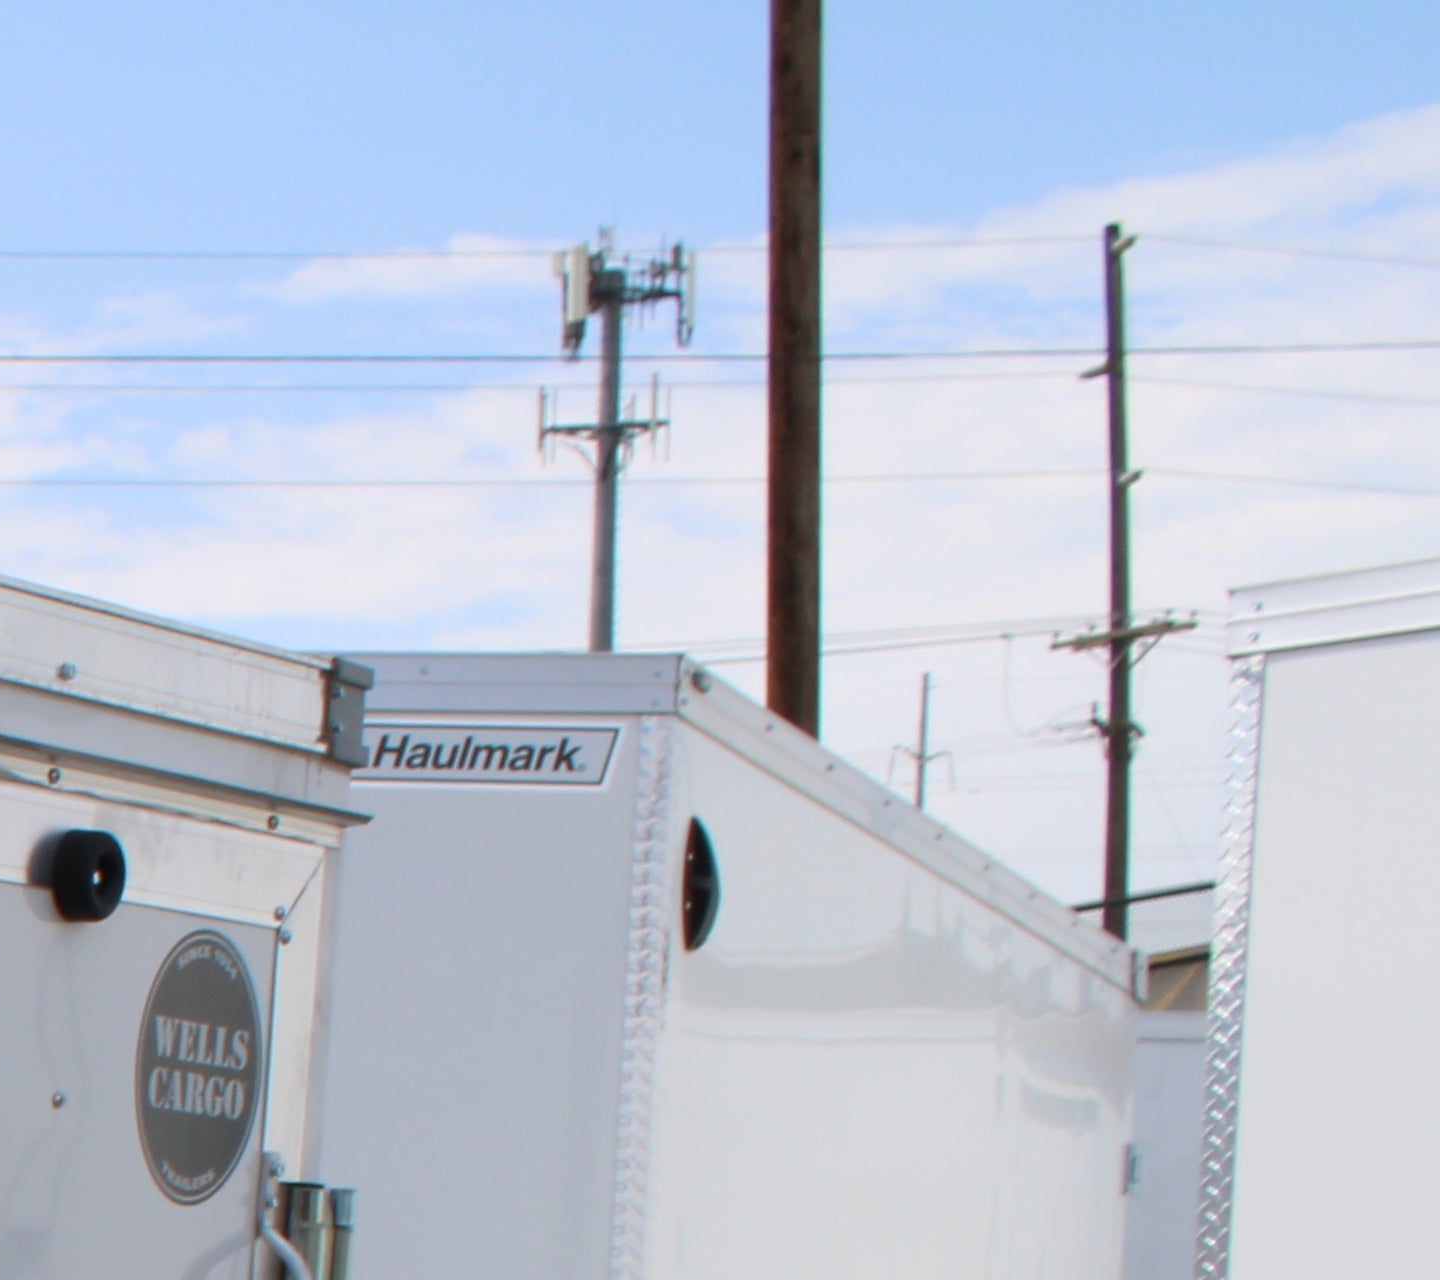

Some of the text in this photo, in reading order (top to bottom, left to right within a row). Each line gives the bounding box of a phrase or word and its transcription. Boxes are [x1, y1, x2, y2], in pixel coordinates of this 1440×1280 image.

[373, 734, 582, 772] Haulmark
[155, 1014, 250, 1071] WELLS
[147, 1066, 246, 1120] CARGO
